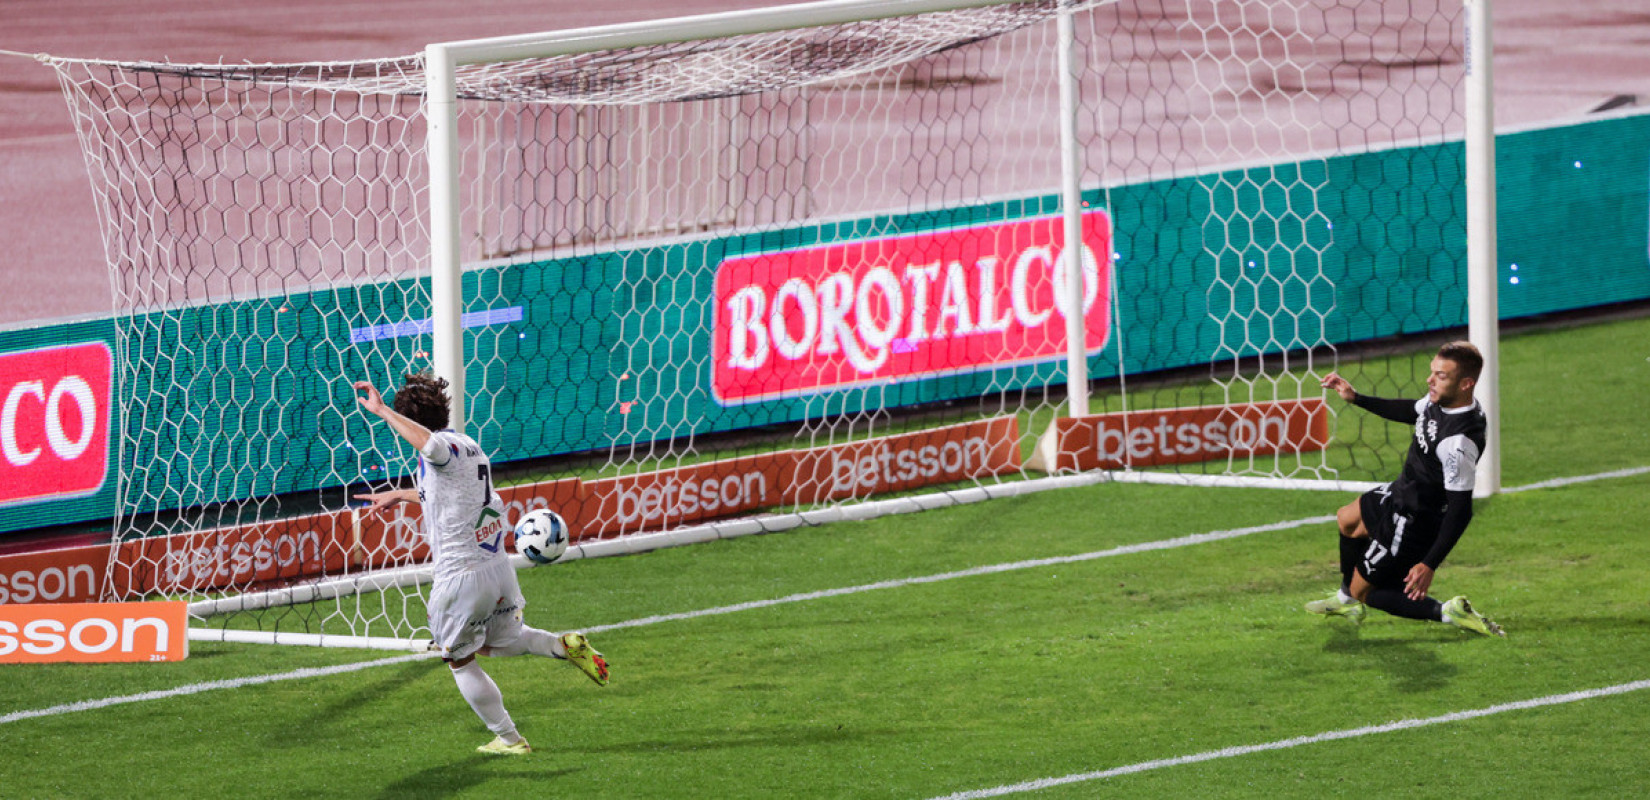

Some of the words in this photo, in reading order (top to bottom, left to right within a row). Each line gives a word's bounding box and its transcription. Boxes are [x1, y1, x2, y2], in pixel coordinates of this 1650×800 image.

[727, 243, 1098, 372] BOROTALCO
[0, 375, 96, 466] CO
[1097, 416, 1286, 461] betsson
[478, 465, 491, 507] 7
[831, 436, 986, 491] betsson
[617, 471, 766, 523] betsson
[166, 530, 319, 583] betsson
[1364, 539, 1388, 565] 17
